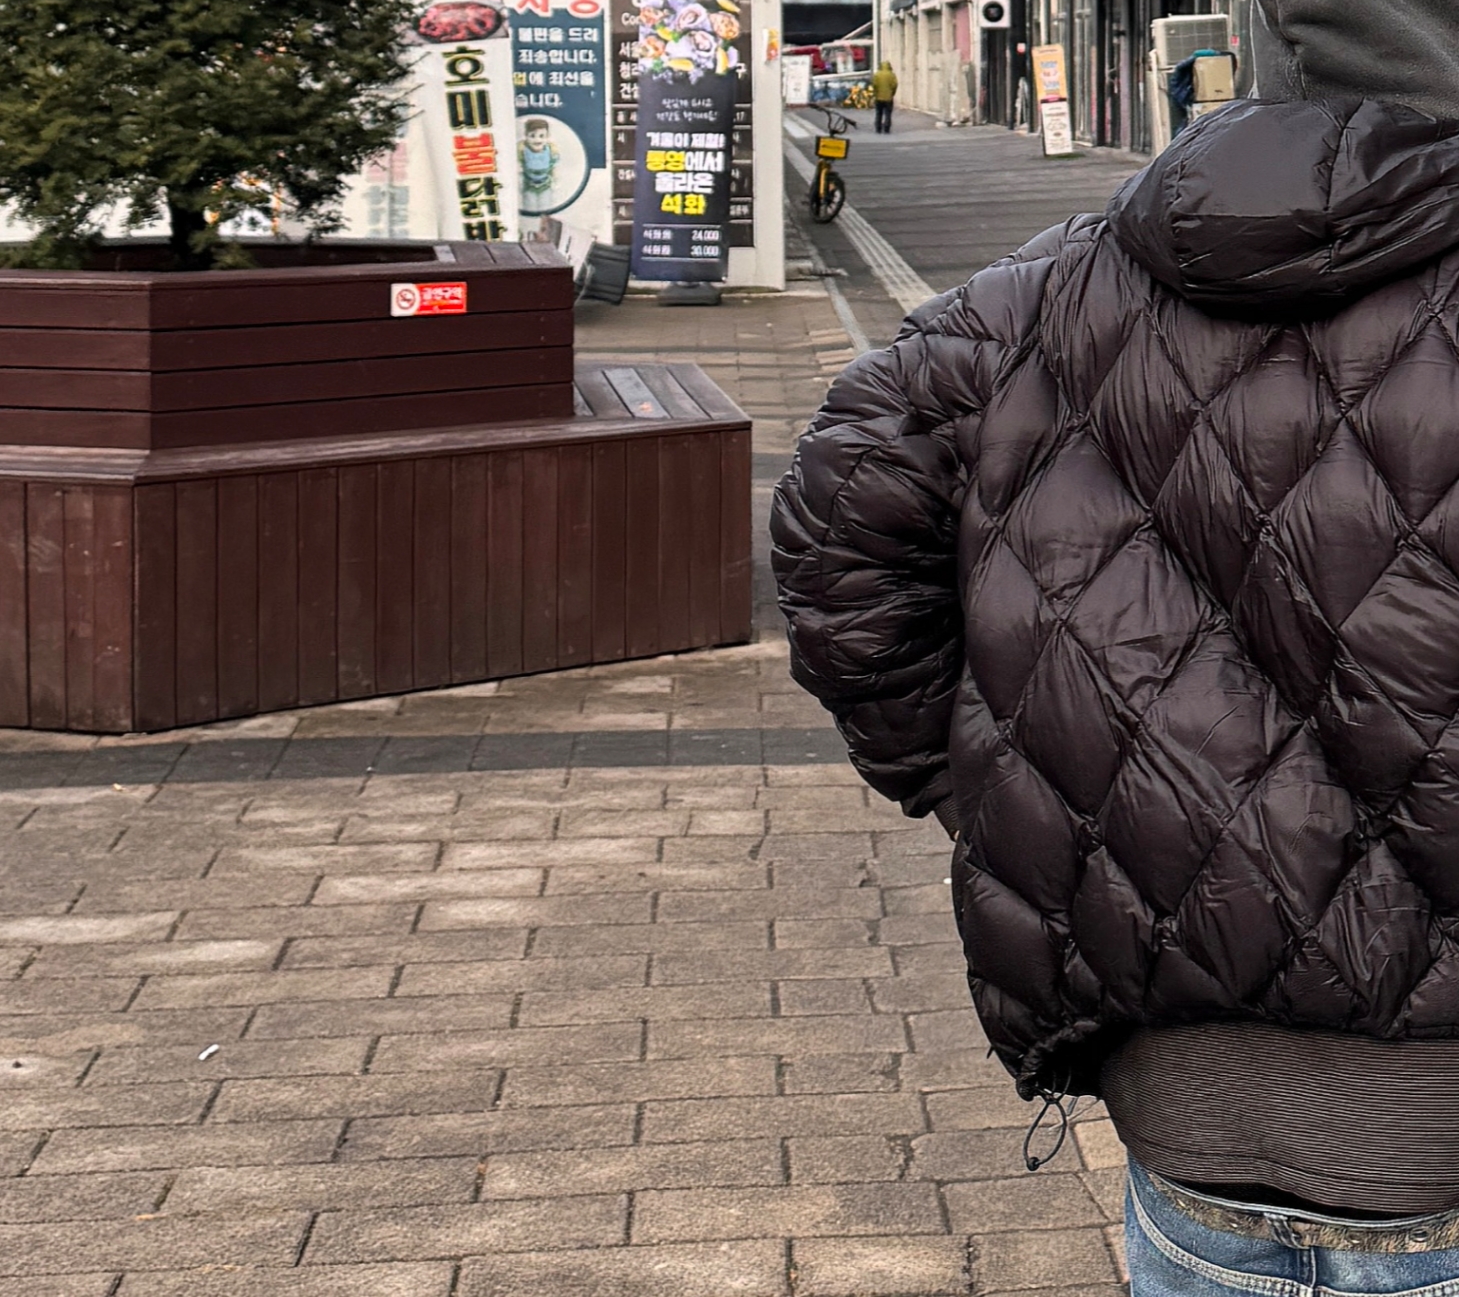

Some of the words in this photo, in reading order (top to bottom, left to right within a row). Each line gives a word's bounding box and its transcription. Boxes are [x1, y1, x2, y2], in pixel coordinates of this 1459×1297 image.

[645, 150, 725, 173] 통영에서
[655, 172, 716, 194] 올라온
[660, 193, 708, 216] 석화
